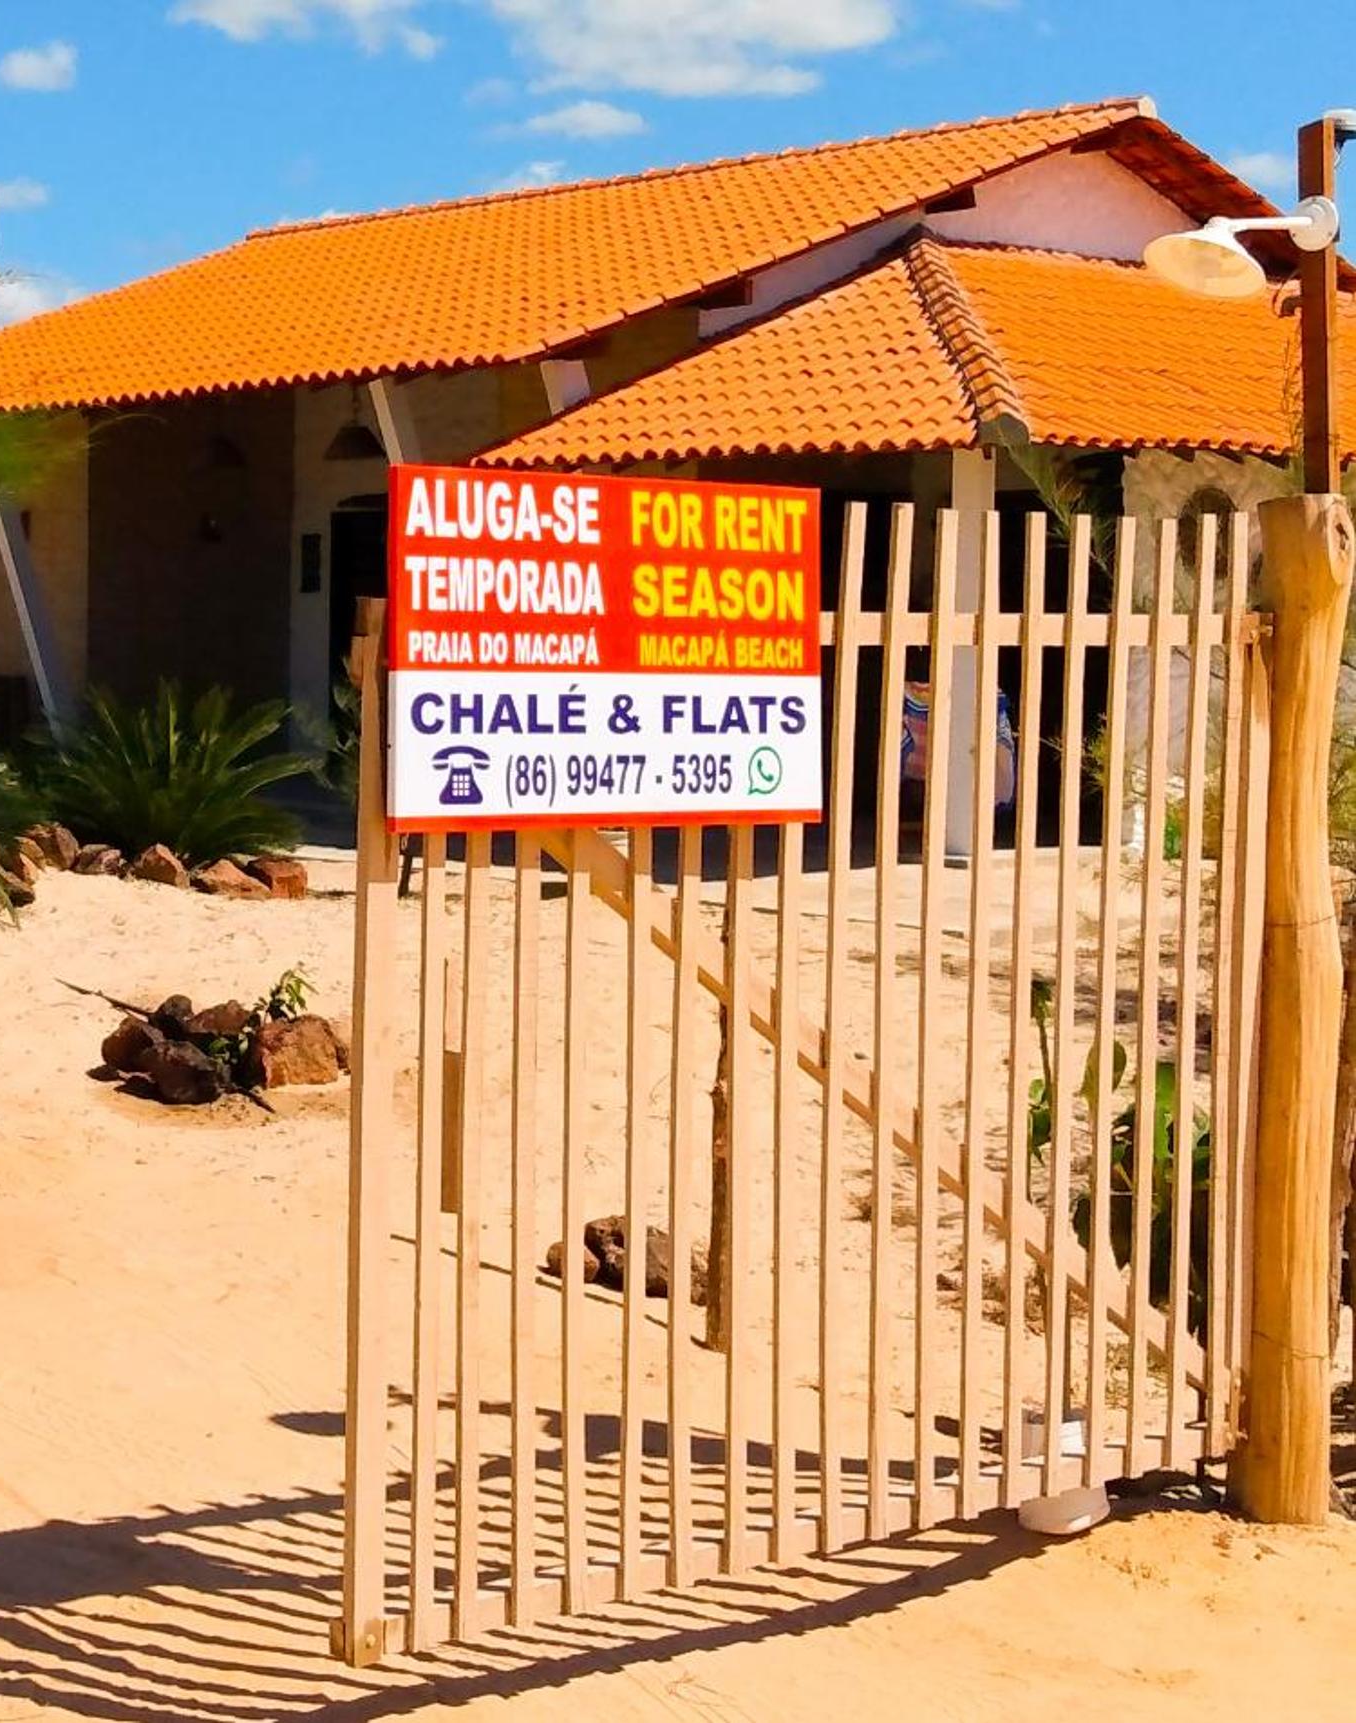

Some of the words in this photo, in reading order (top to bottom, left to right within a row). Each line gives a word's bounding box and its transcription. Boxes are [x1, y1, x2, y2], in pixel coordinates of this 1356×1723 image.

[405, 477, 601, 545] ALUGA-SE
[631, 490, 703, 549] FOR
[715, 496, 807, 554] RENT
[405, 555, 604, 615] TEMPORADA
[632, 564, 804, 621] SEASON
[408, 631, 473, 664] PRAIA
[479, 633, 509, 664] DO
[515, 629, 599, 666] MACAPÁ
[639, 630, 728, 667] MACAPÁ
[734, 636, 803, 668] BEACH
[410, 684, 587, 735] CHALÉ
[607, 694, 642, 734] &
[663, 695, 806, 735] FLATS
[506, 754, 557, 807] (86)
[567, 754, 646, 795] 99477
[672, 754, 733, 795] 5395
